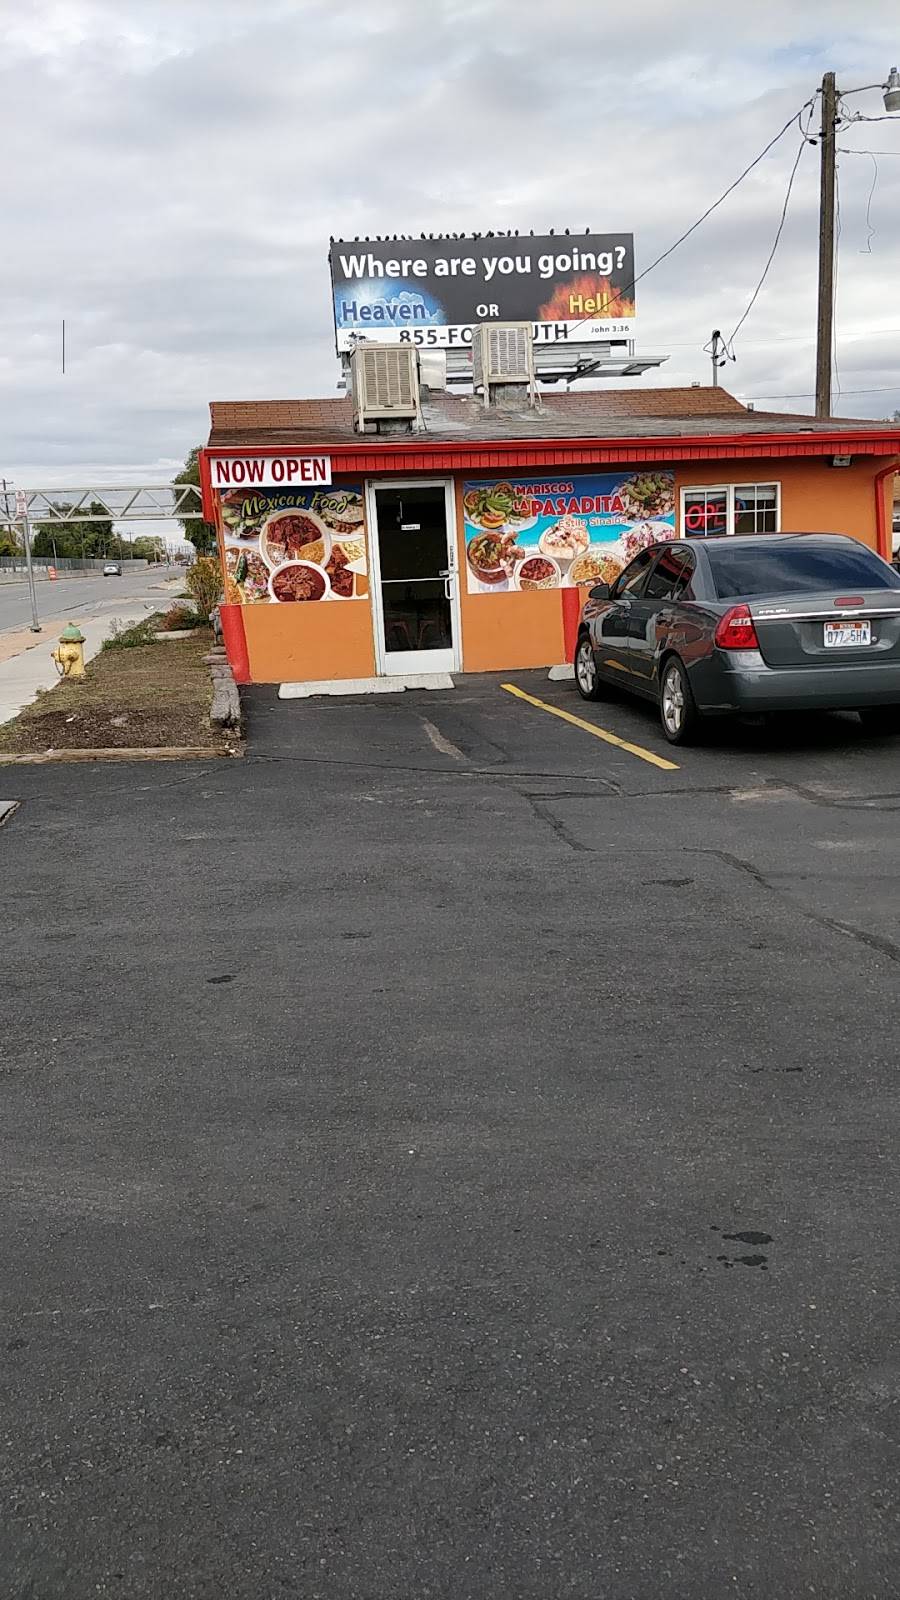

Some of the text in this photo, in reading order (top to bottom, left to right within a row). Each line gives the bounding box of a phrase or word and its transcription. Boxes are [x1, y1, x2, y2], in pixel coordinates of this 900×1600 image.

[339, 246, 626, 282] Where are you going?
[341, 300, 426, 321] Heaven
[476, 303, 500, 318] OR
[569, 292, 609, 314] Hell
[591, 325, 630, 334] John 3:36
[216, 458, 327, 484] NOW OPEN
[515, 483, 574, 496] MARISCOS
[241, 490, 350, 518] Mexican Food
[513, 495, 625, 517] LA PASADITA
[558, 516, 628, 528] Estilo Sinaloa
